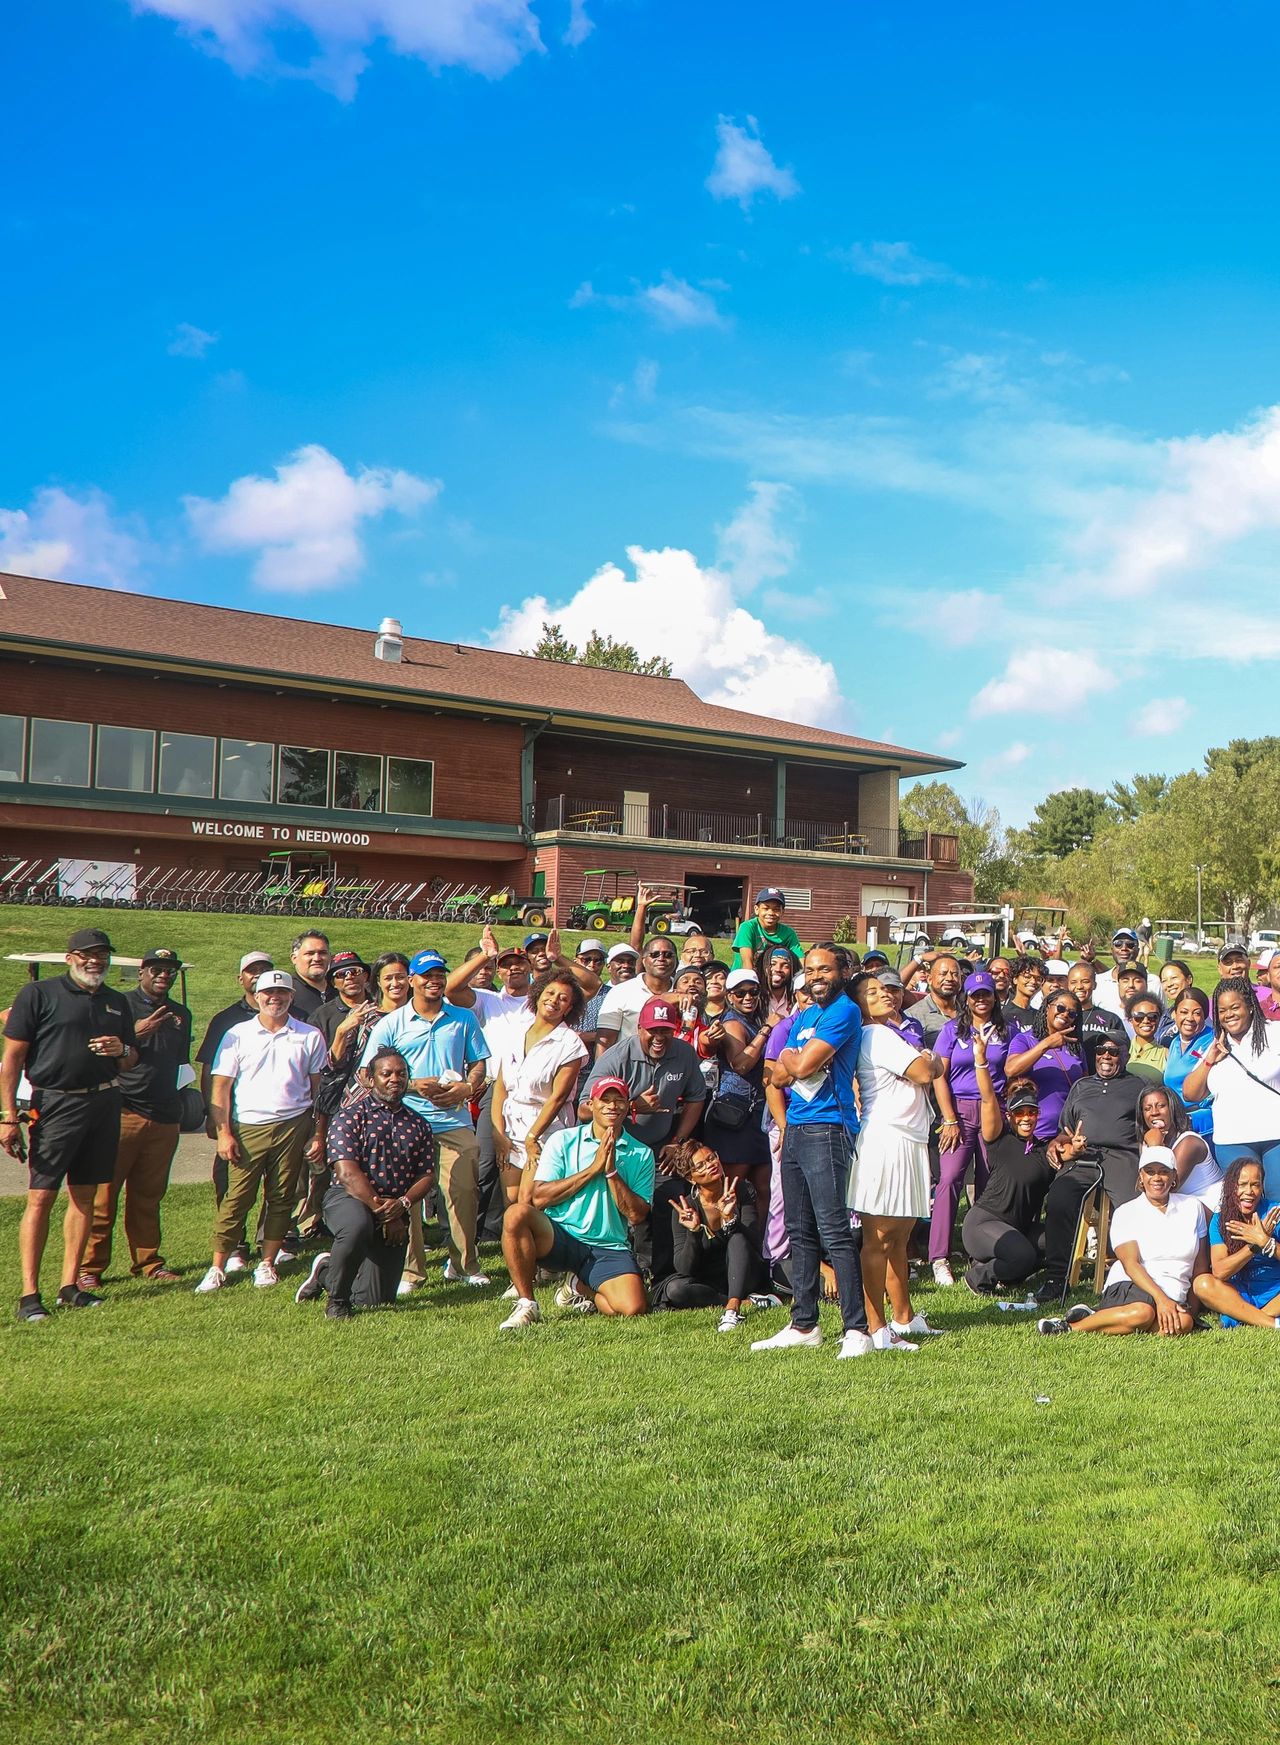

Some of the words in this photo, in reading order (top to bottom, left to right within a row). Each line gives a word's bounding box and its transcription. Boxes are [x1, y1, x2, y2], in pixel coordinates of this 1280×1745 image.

[192, 821, 264, 839] WELCOME
[272, 827, 290, 841] TO
[296, 829, 370, 846] NEEDWOOD
[273, 973, 282, 983] P
[654, 1006, 668, 1018] M
